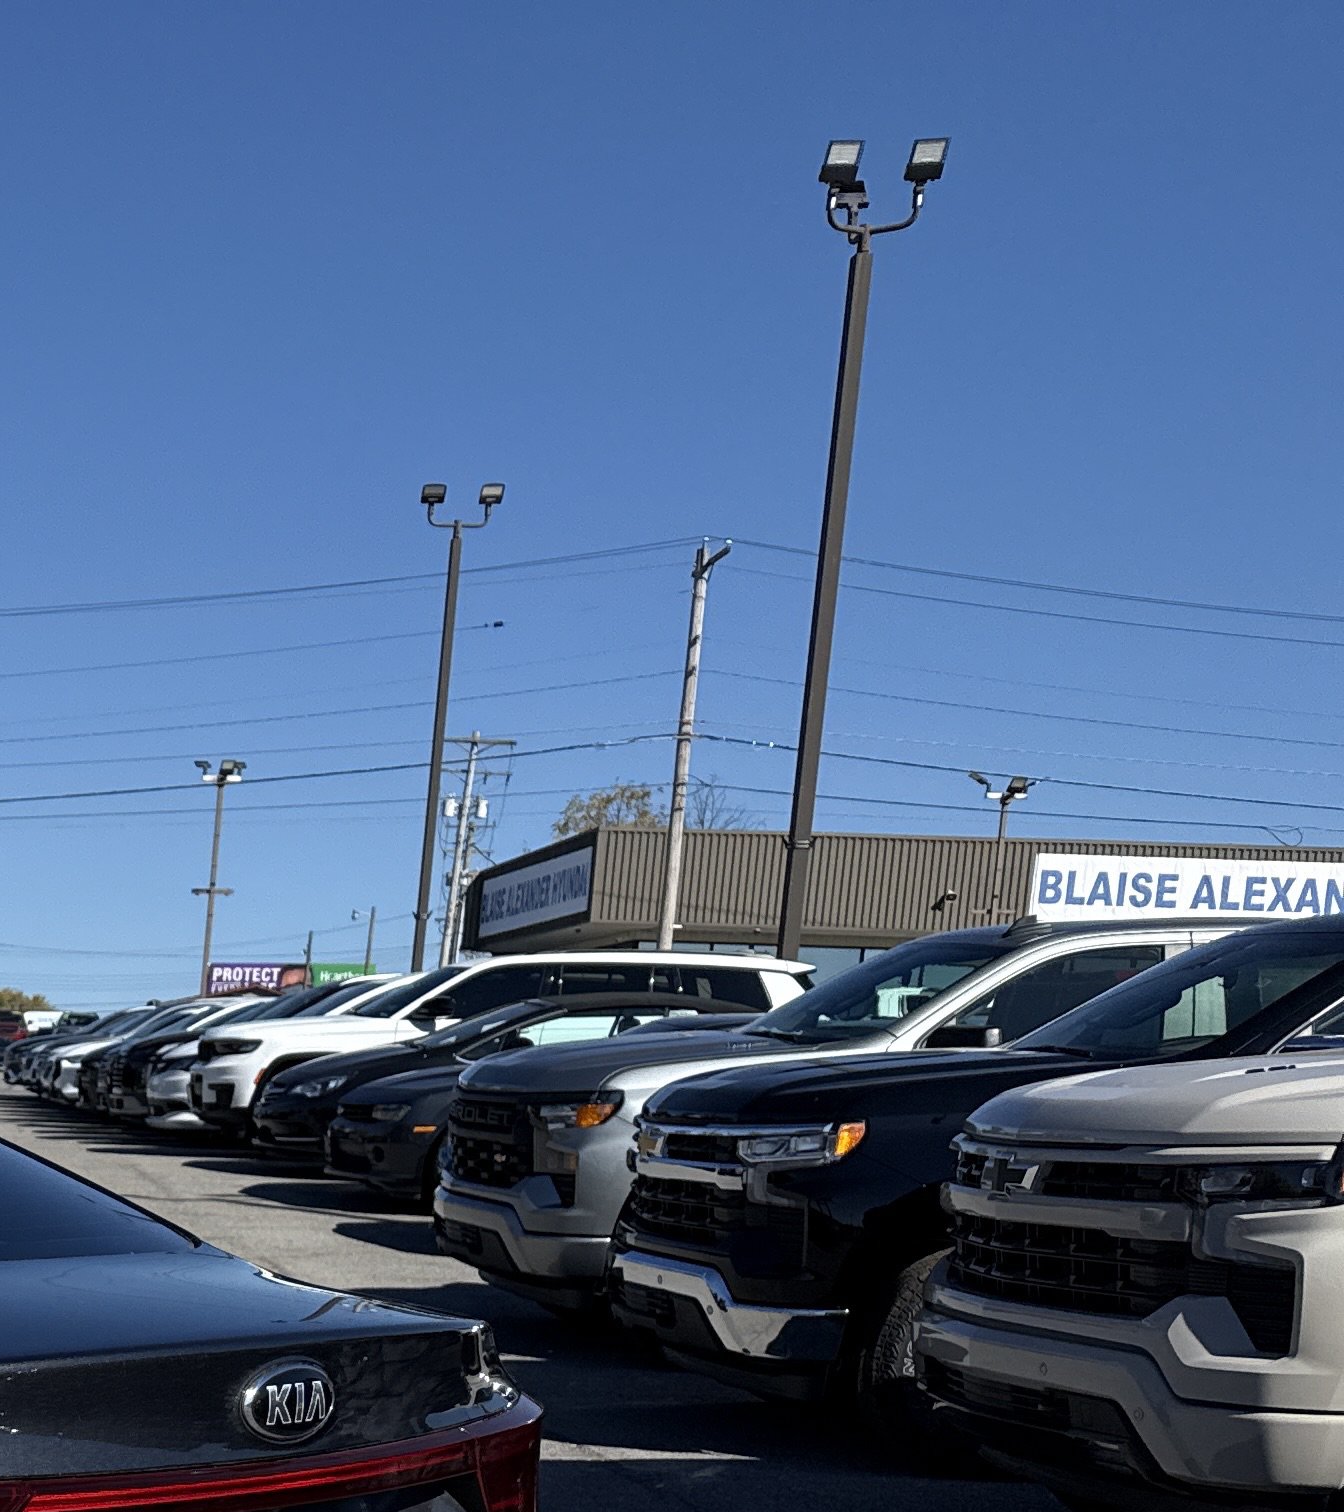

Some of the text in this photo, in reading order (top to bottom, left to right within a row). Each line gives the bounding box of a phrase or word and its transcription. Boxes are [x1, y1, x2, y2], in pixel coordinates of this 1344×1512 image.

[1038, 869, 1344, 915] BLAISE ALEXAN
[212, 966, 281, 982] PROTECT
[265, 1380, 327, 1426] KIA
